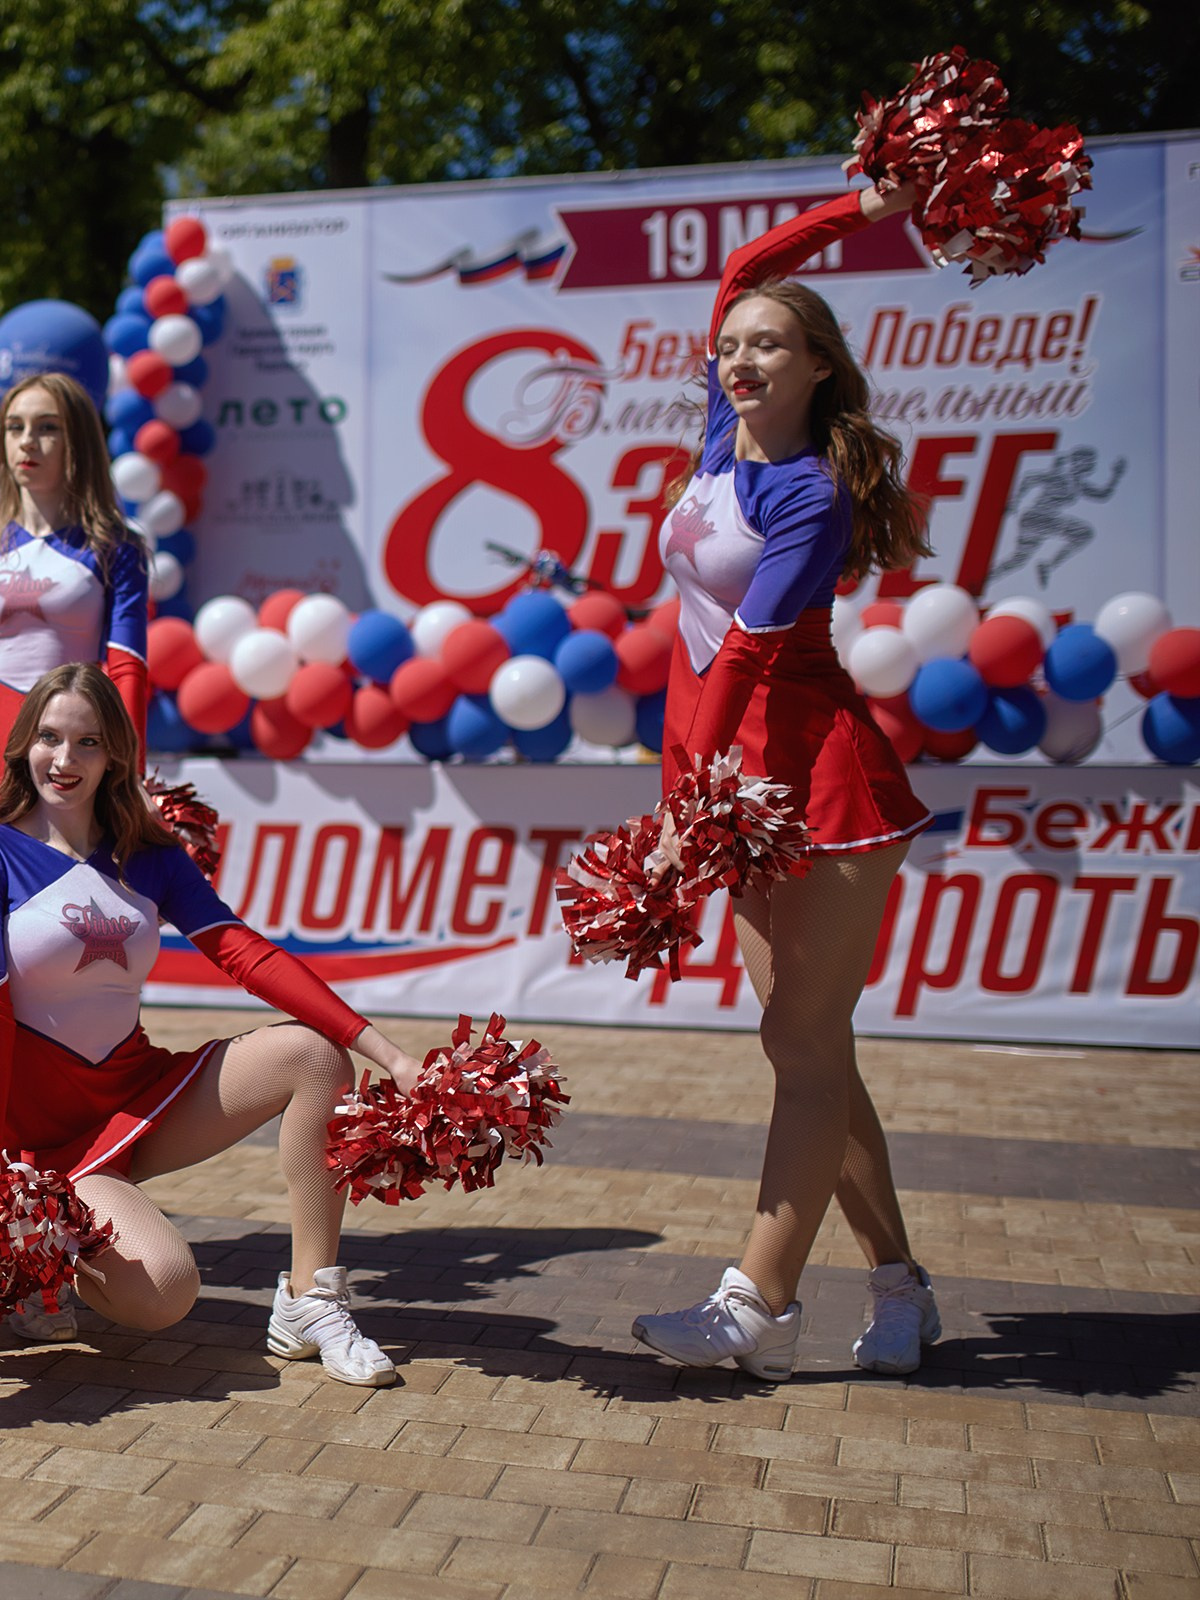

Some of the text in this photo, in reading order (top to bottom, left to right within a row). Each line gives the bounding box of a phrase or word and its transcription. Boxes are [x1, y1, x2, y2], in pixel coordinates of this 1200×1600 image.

[641, 206, 709, 280] 19
[863, 295, 1099, 372] Победе!
[382, 326, 605, 614] 8
[588, 429, 1059, 605] ЗЕГ
[62, 903, 135, 938] Time
